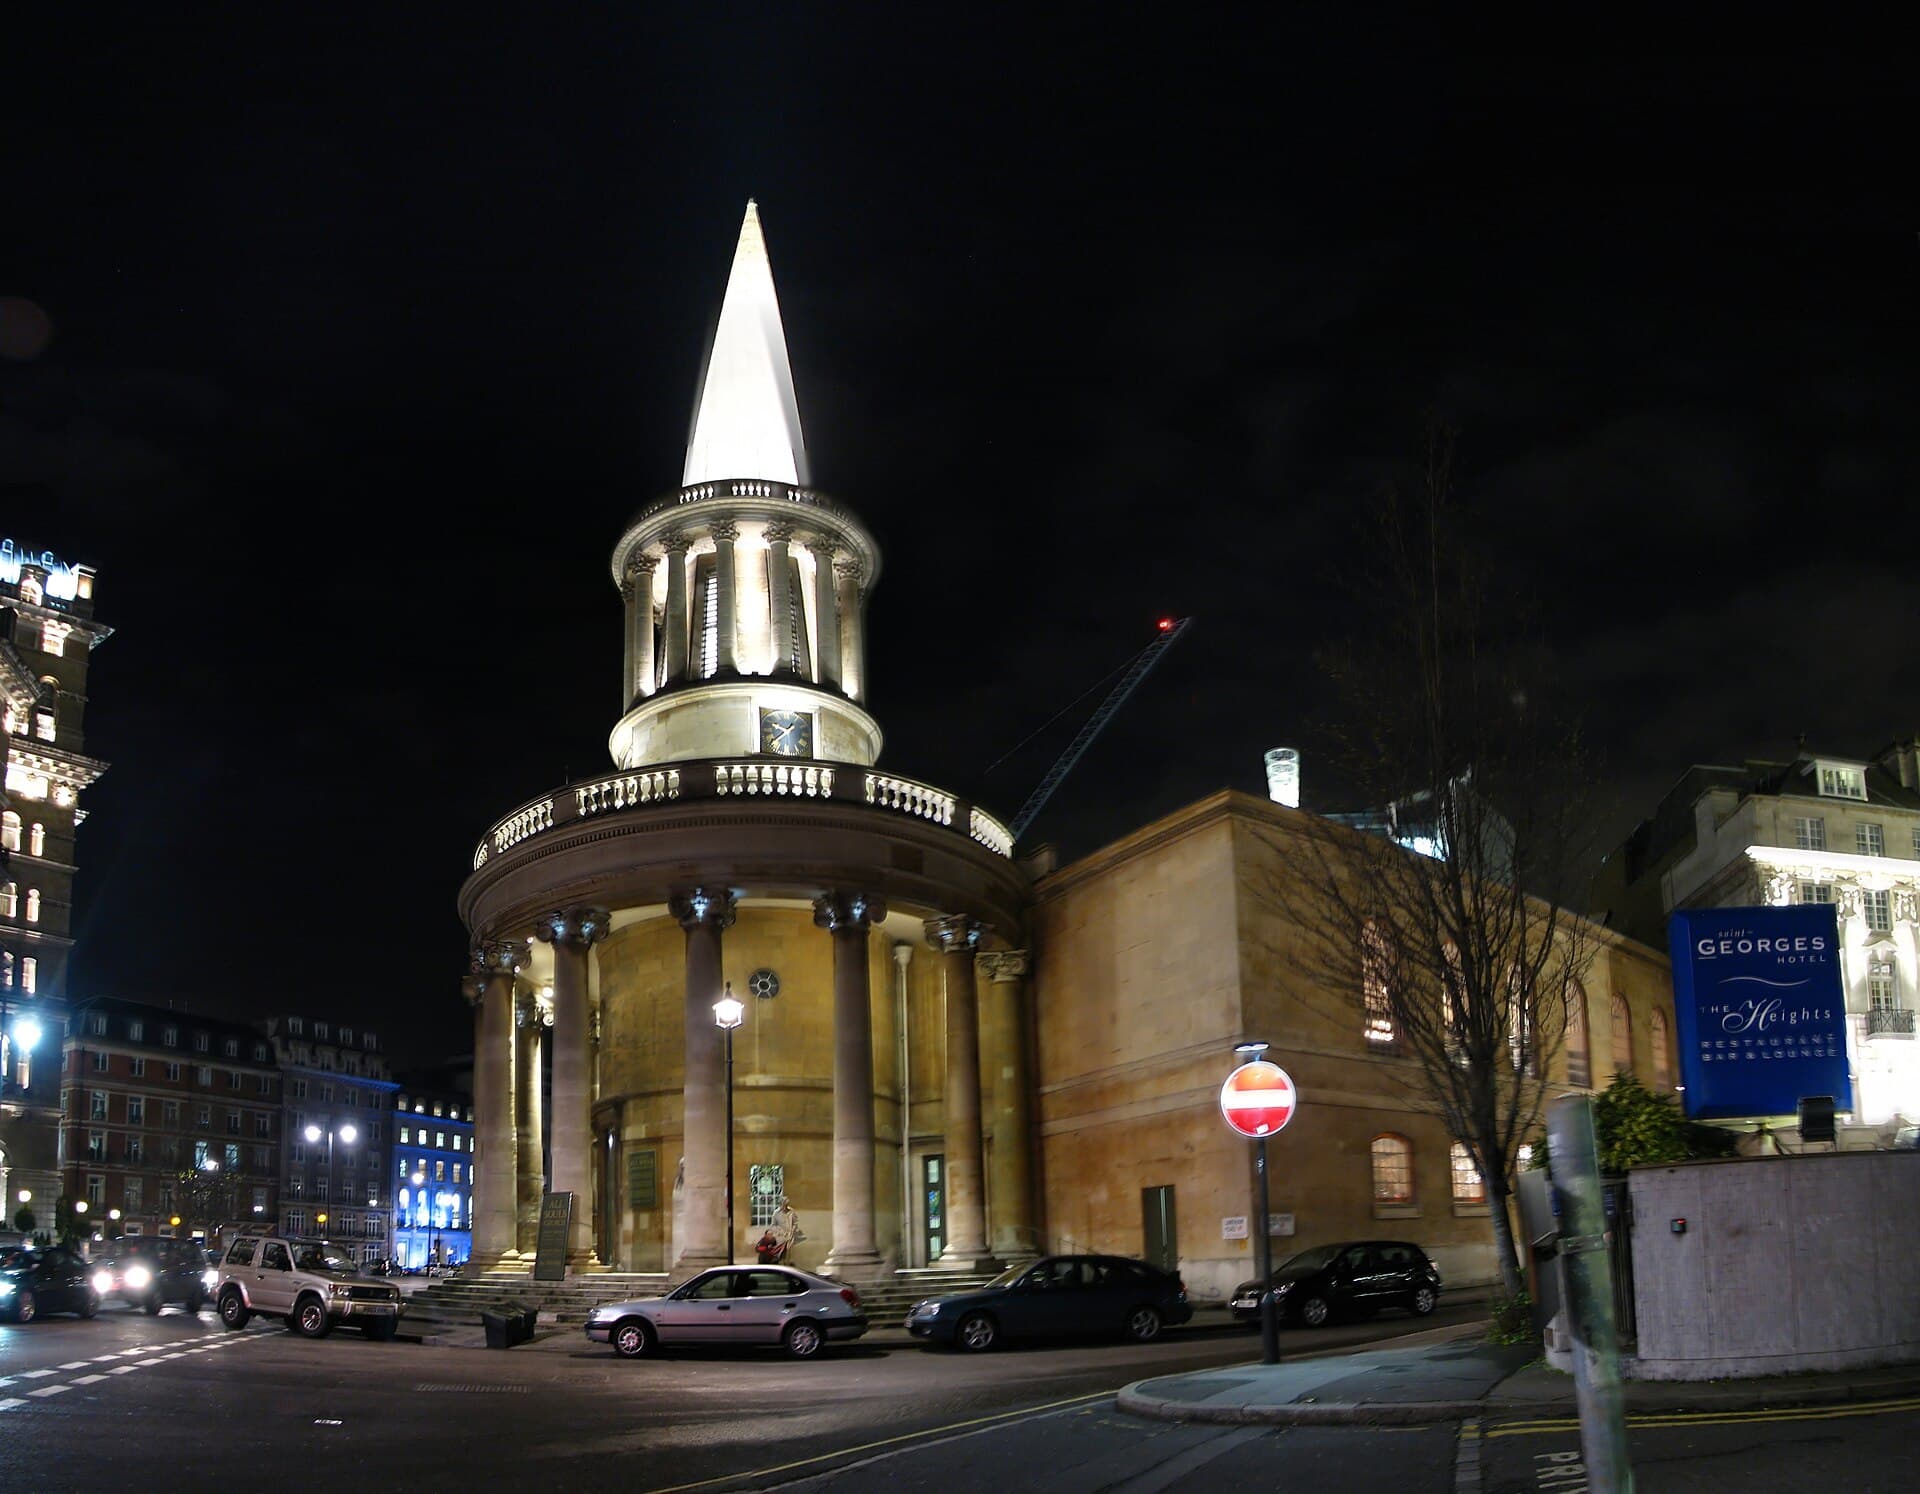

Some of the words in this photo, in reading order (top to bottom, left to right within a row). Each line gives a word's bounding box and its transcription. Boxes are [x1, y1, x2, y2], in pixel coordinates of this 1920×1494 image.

[1697, 936, 1825, 956] GEORGES
[1777, 954, 1826, 964] HOTEL
[1721, 998, 1831, 1034] Heights
[1701, 1034, 1837, 1049] RESTAURANT
[1701, 1051, 1739, 1062] BAR
[1744, 1051, 1758, 1061] &
[1761, 1048, 1839, 1060] LOUNGE
